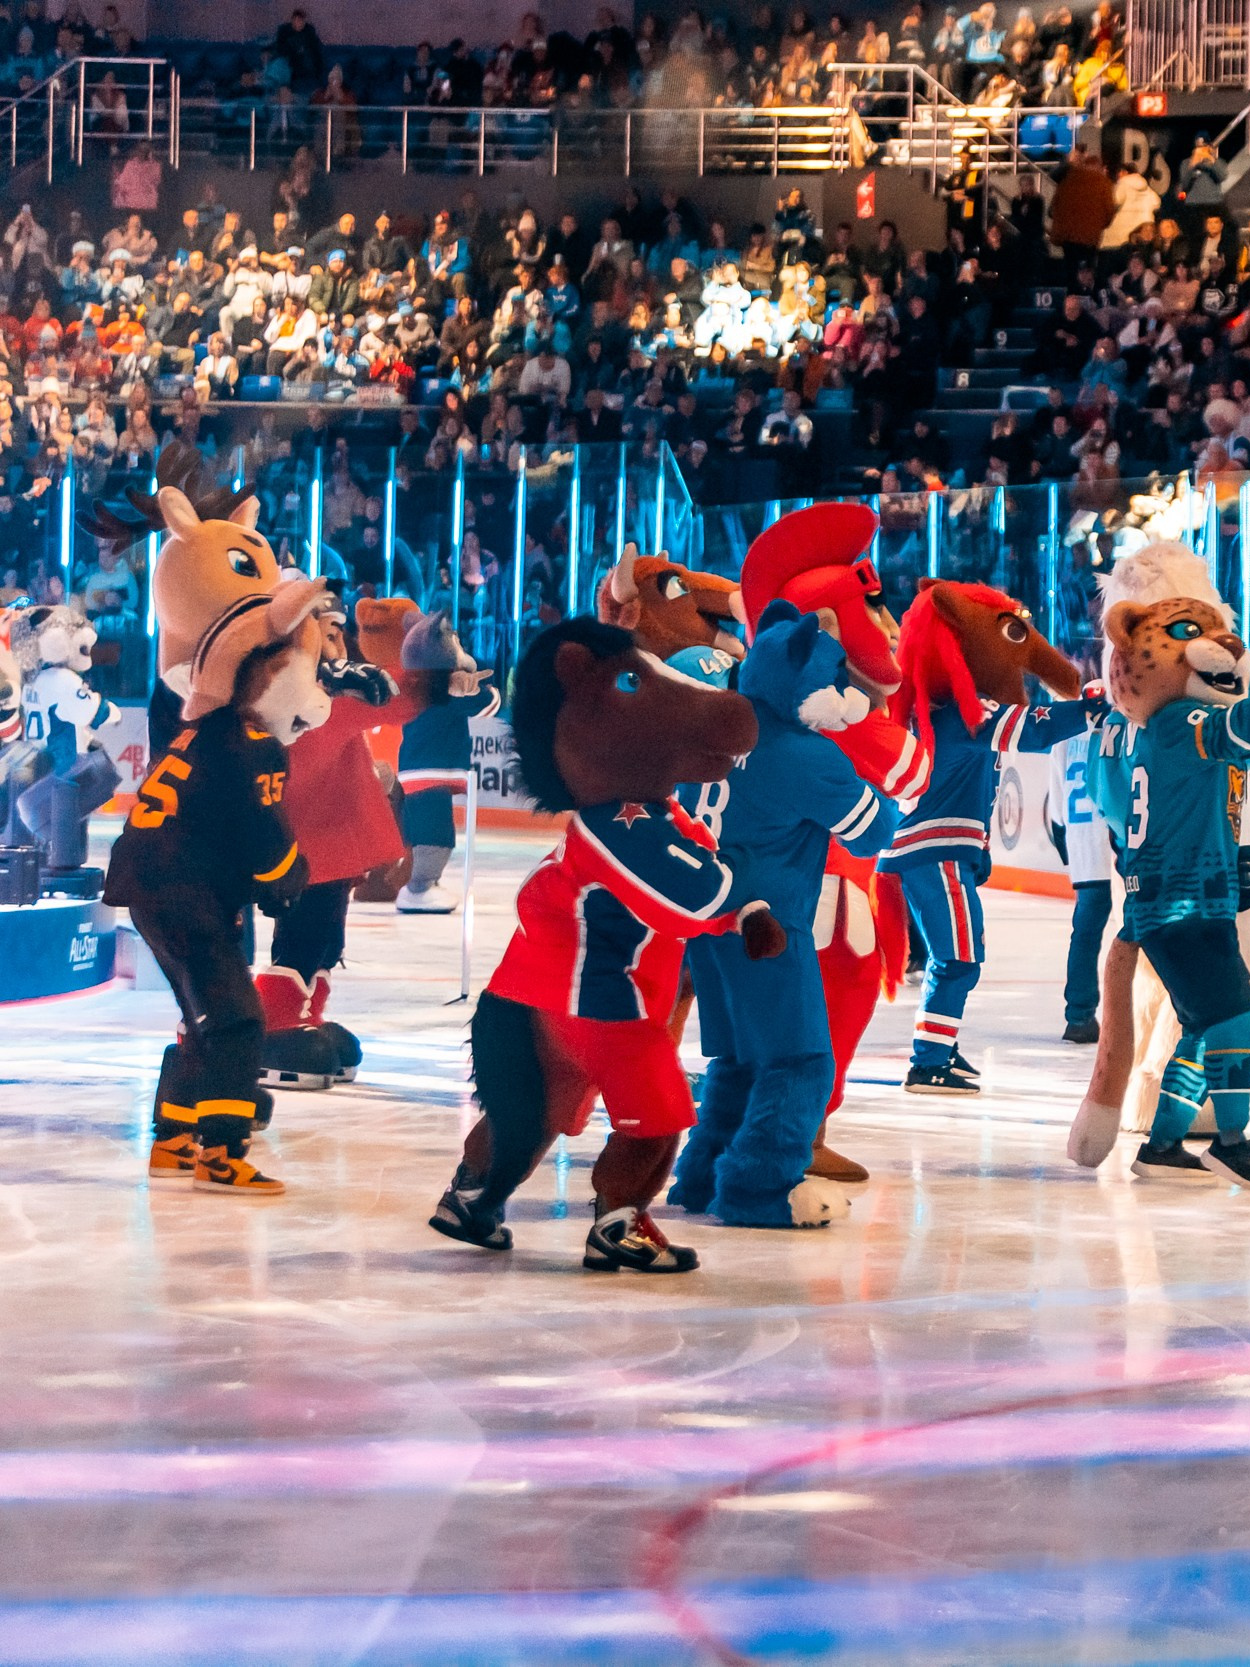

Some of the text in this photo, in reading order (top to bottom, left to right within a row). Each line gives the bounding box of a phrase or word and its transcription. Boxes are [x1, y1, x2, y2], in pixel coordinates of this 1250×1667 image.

[1034, 290, 1053, 308] 10
[996, 329, 1008, 347] 9
[698, 648, 734, 676] 48
[256, 771, 287, 806] 35
